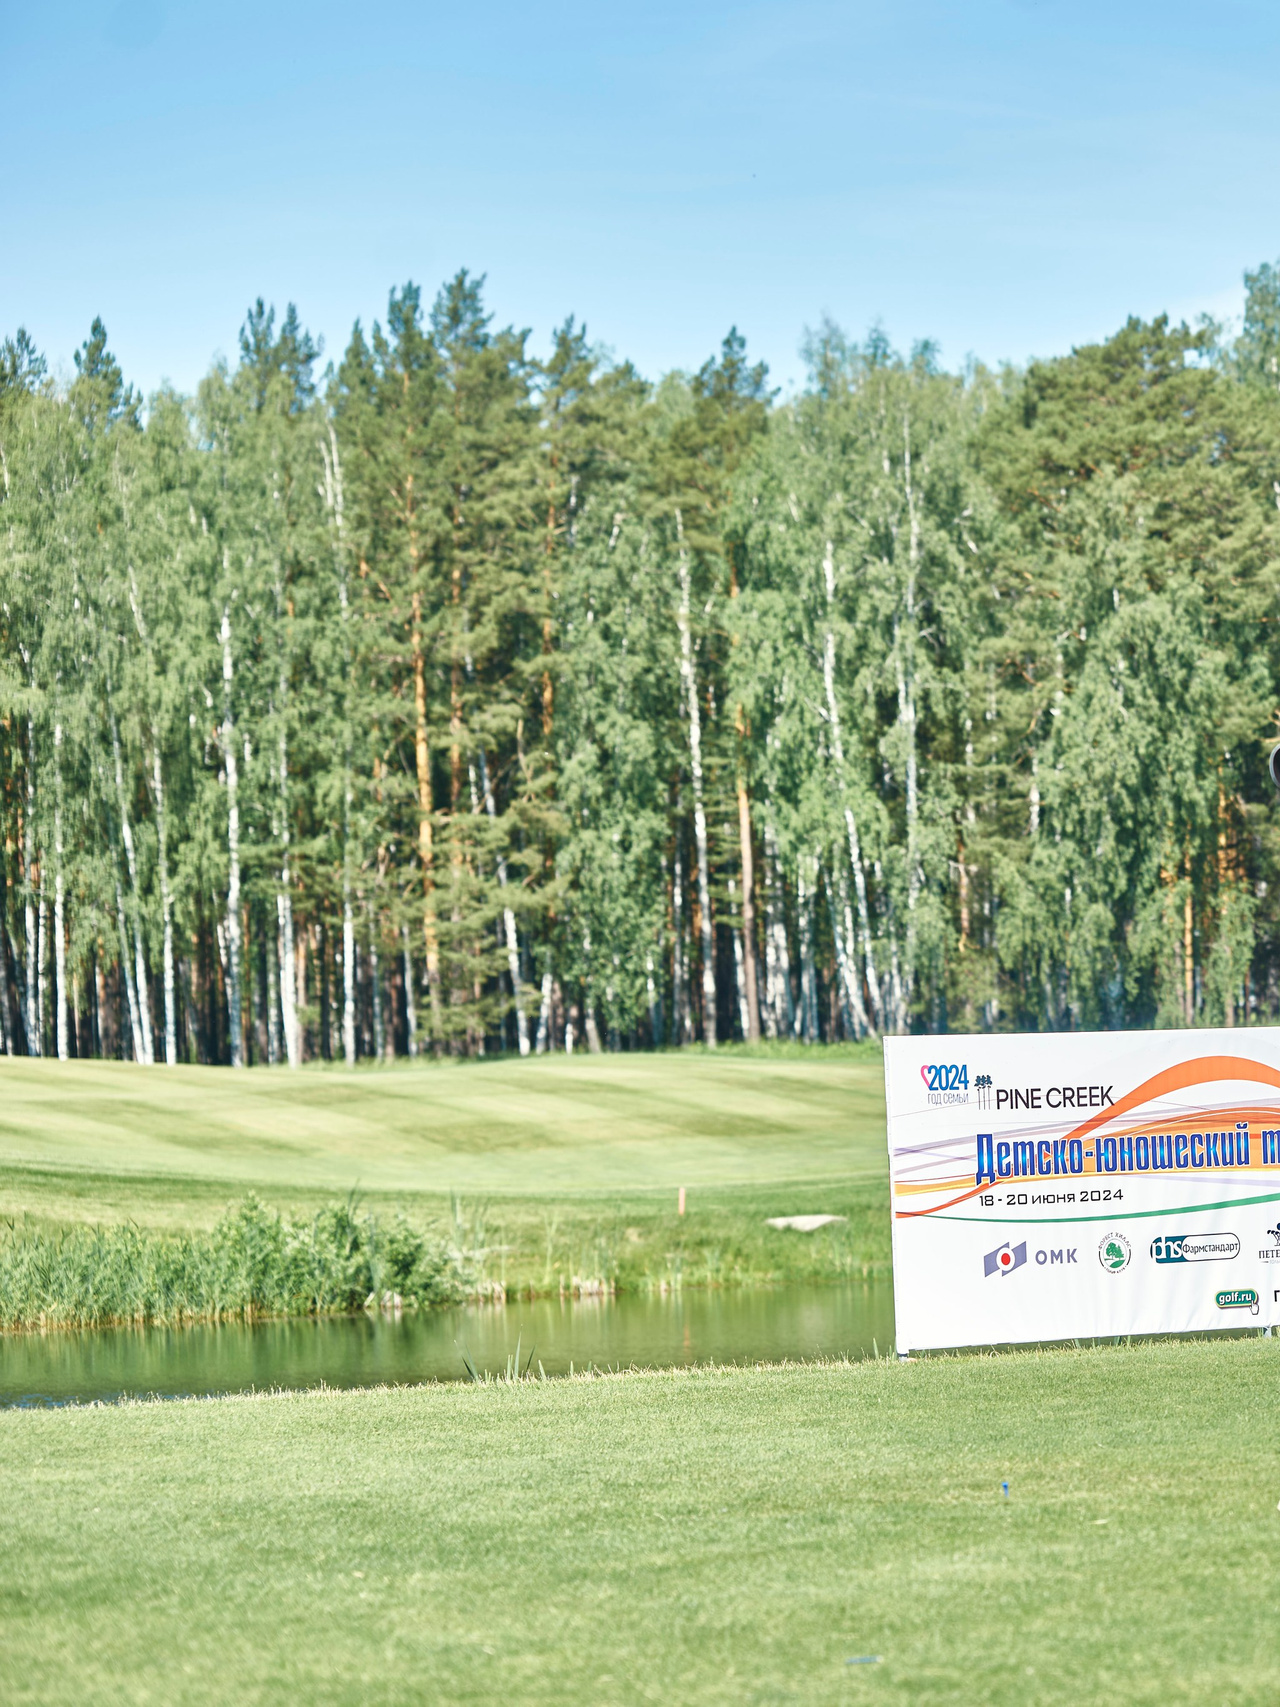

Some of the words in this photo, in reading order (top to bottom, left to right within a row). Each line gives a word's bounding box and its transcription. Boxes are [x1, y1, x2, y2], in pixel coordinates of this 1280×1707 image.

[927, 1064, 969, 1091] 2024
[996, 1087, 1042, 1110] PINE
[1046, 1085, 1115, 1108] CREEK
[975, 1122, 1250, 1186] Детско-юношеский
[980, 1195, 994, 1207] 18
[1006, 1193, 1028, 1206] 20
[1080, 1189, 1124, 1202] 2024
[1035, 1248, 1078, 1265] ОМК
[1182, 1243, 1238, 1255] Фармстандарт
[1219, 1291, 1252, 1305] golf.ru
